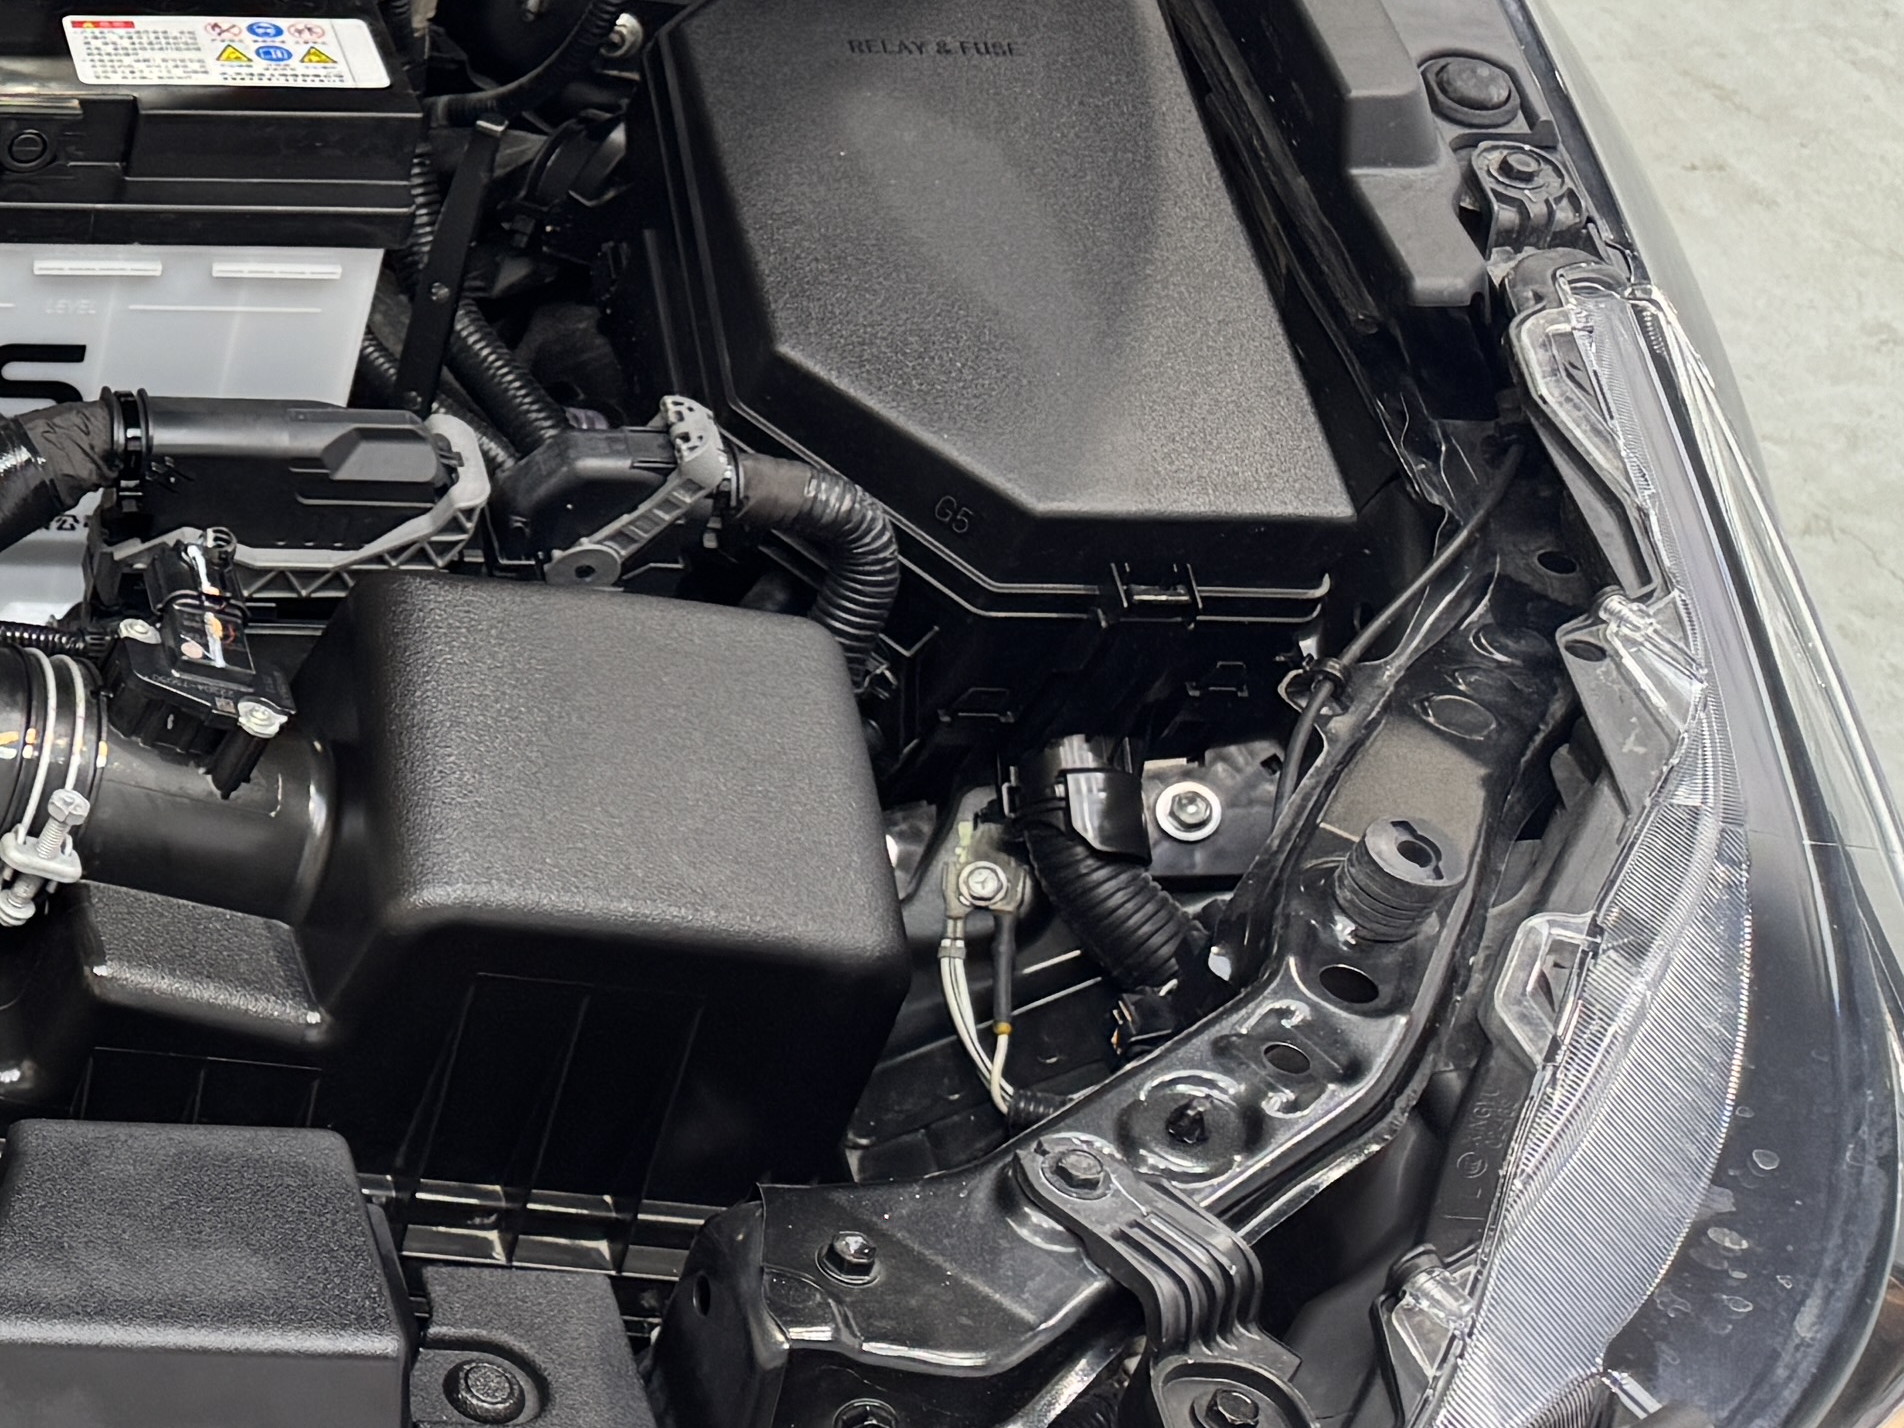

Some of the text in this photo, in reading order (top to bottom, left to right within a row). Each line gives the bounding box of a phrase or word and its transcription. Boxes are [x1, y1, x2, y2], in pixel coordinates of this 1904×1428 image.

[846, 38, 1028, 58] RELAY & FUSE
[45, 298, 96, 315] LEVEL
[934, 494, 976, 534] G5
